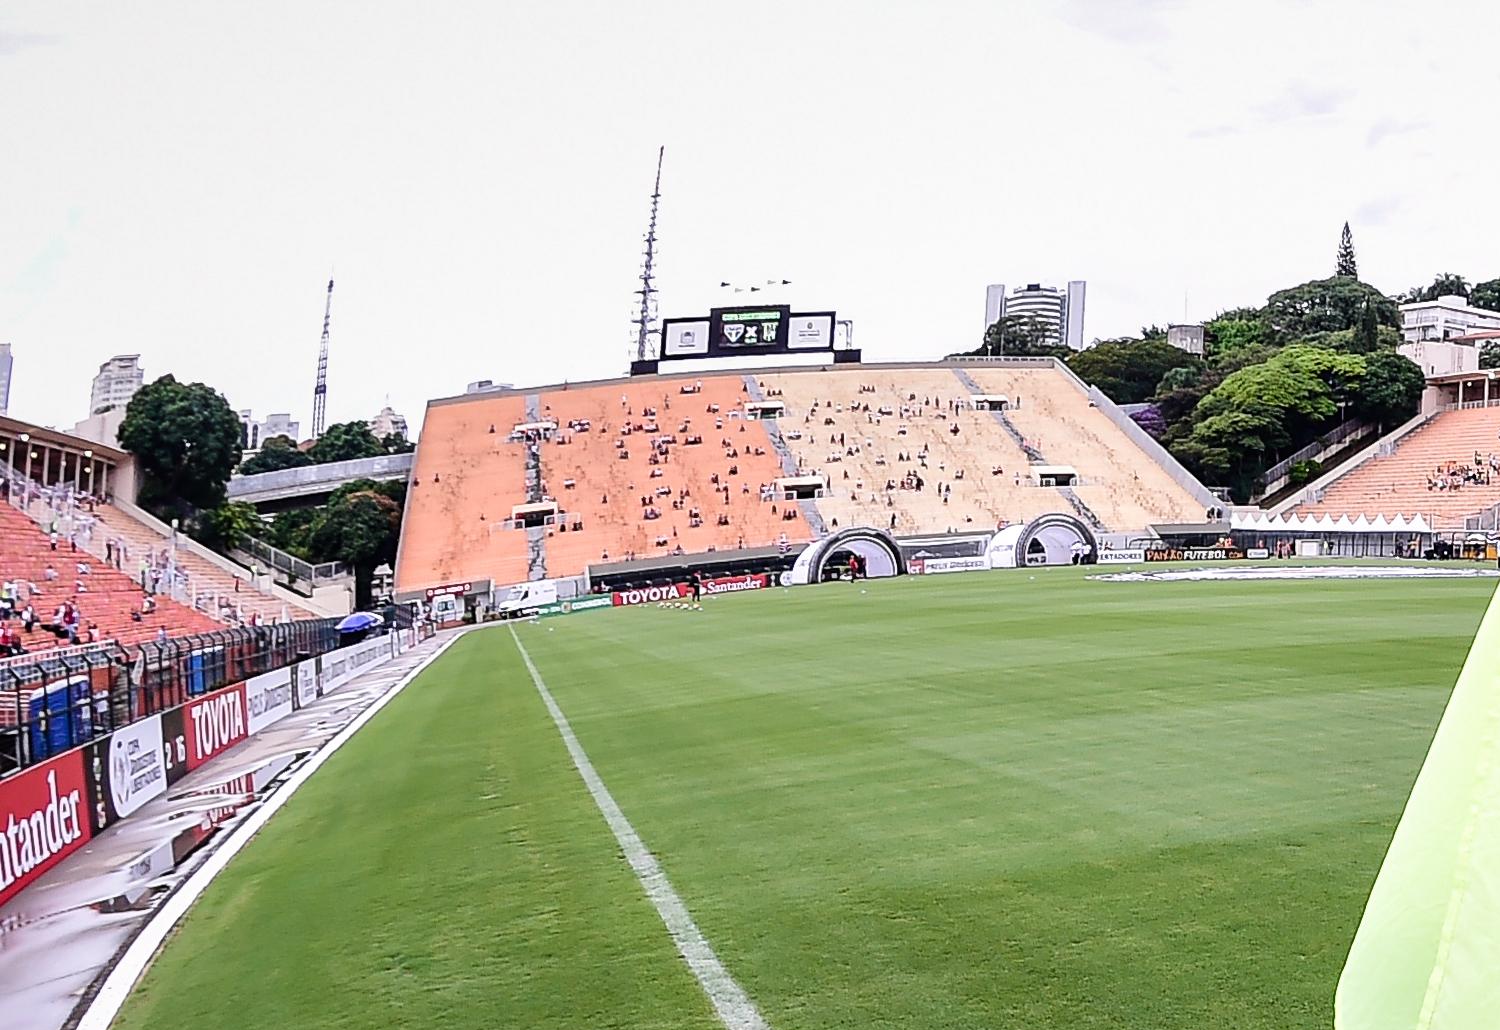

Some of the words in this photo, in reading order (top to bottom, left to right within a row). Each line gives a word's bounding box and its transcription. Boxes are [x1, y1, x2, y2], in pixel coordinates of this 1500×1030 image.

[619, 585, 680, 605] TOYOTA
[706, 578, 763, 594] Santander
[191, 689, 245, 760] TOYOTA
